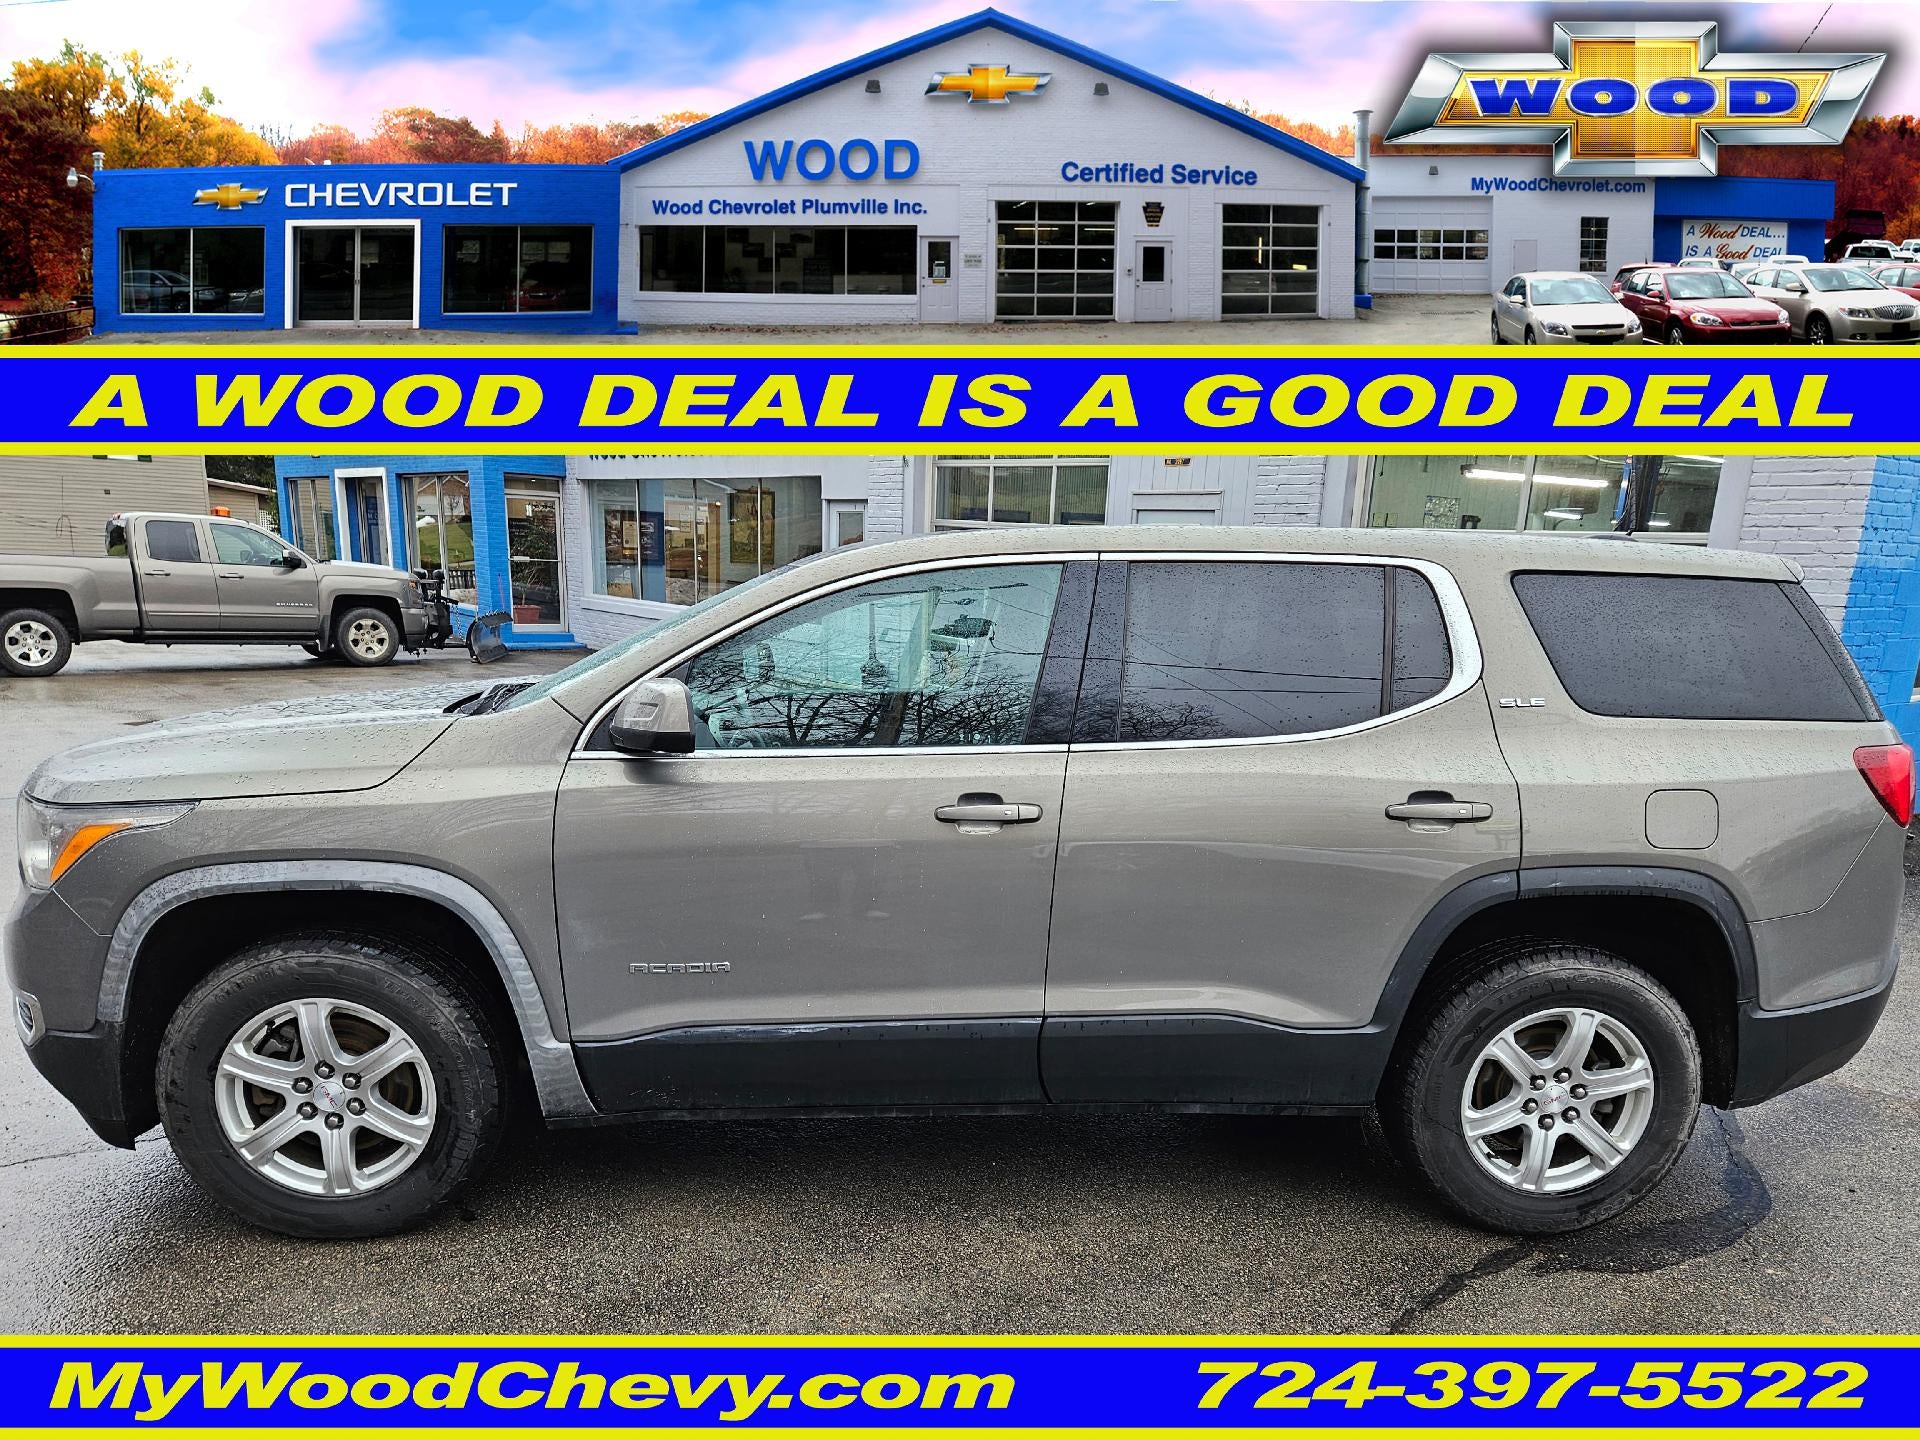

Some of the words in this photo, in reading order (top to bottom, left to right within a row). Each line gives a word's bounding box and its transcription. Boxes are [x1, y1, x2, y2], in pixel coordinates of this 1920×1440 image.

[743, 138, 921, 182] WOOD
[1060, 160, 1165, 184] Certified
[1170, 163, 1258, 186] Service
[1471, 177, 1646, 194] MyWoodChevrolet.com
[285, 183, 518, 207] CHEVROLET
[651, 199, 703, 215] Wood
[708, 199, 796, 215] Chevrolet
[801, 200, 888, 215] Plumville
[893, 200, 928, 215] Inc.
[1686, 224, 1696, 237] A
[1699, 222, 1744, 240] Wood
[1685, 245, 1699, 257] IS
[1703, 245, 1713, 258] A
[1715, 243, 1755, 260] Good
[1499, 697, 1546, 708] SLE
[629, 961, 731, 974] ACADIA
